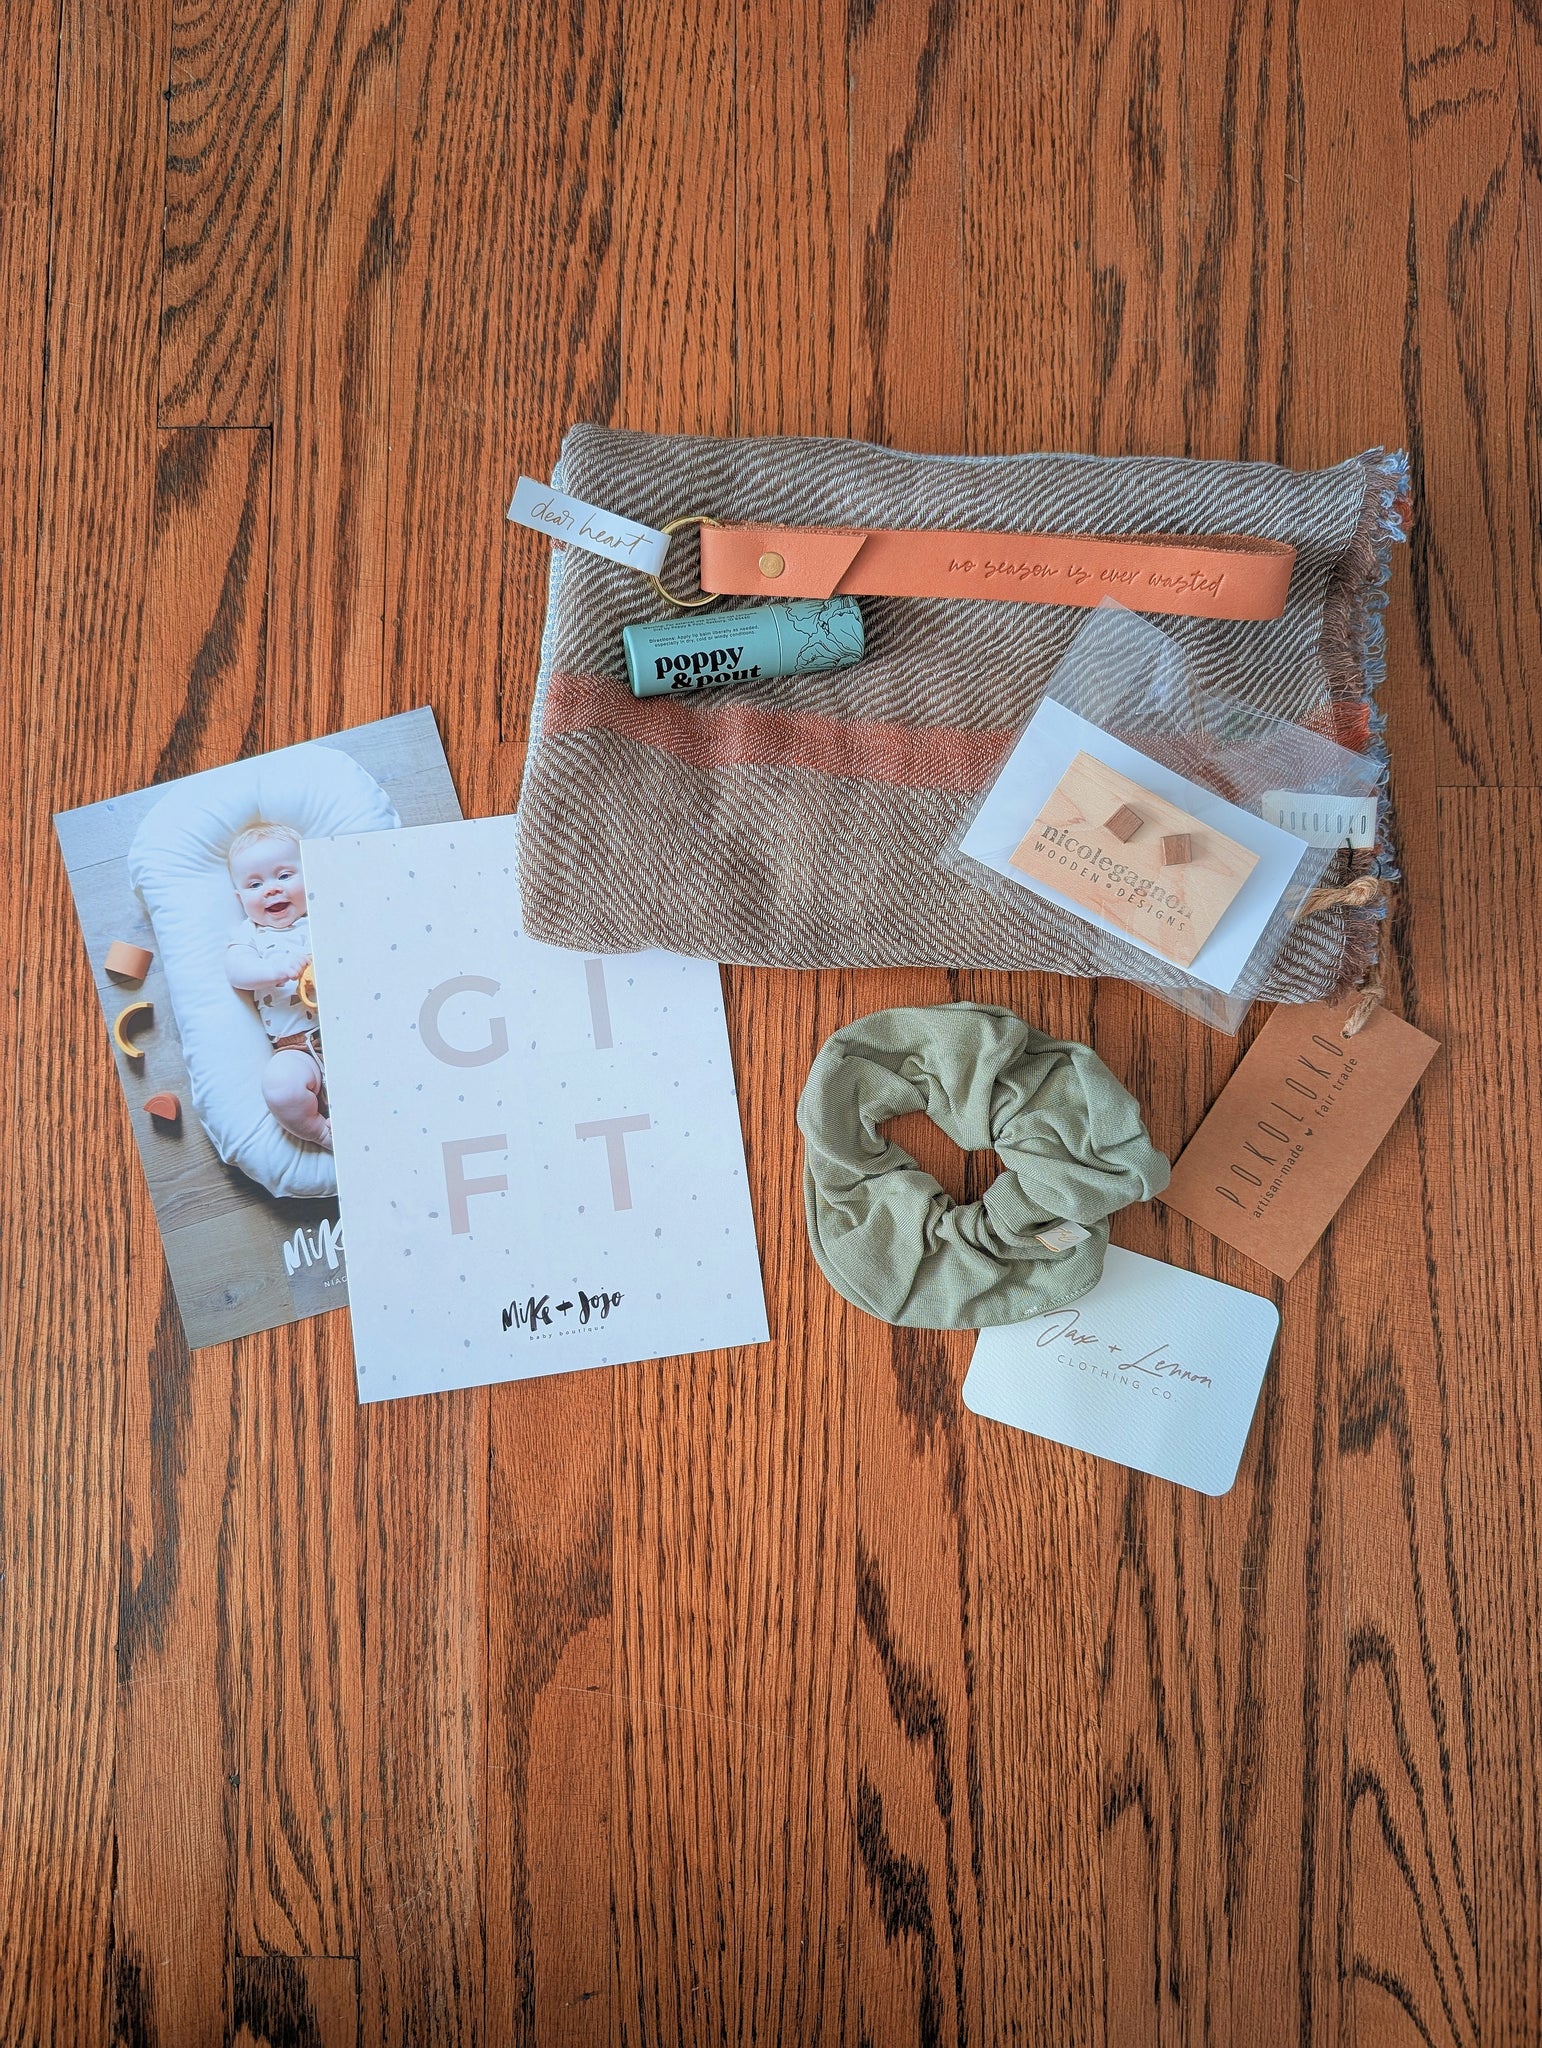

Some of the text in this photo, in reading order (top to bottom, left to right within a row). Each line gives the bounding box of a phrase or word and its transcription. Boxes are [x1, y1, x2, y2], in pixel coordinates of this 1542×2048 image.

[530, 498, 654, 555] dear heart
[948, 559, 1226, 598] no season is ever wasted
[654, 646, 744, 680] poppy
[1034, 840, 1186, 932] WOODEN DESIGNS
[1215, 1034, 1344, 1209] POKOLOKO
[1252, 1057, 1358, 1219] artisan-made fair trade
[1036, 1308, 1099, 1349] Jax
[1117, 1343, 1213, 1389] Lennon
[1057, 1354, 1141, 1390] CLOTHING
